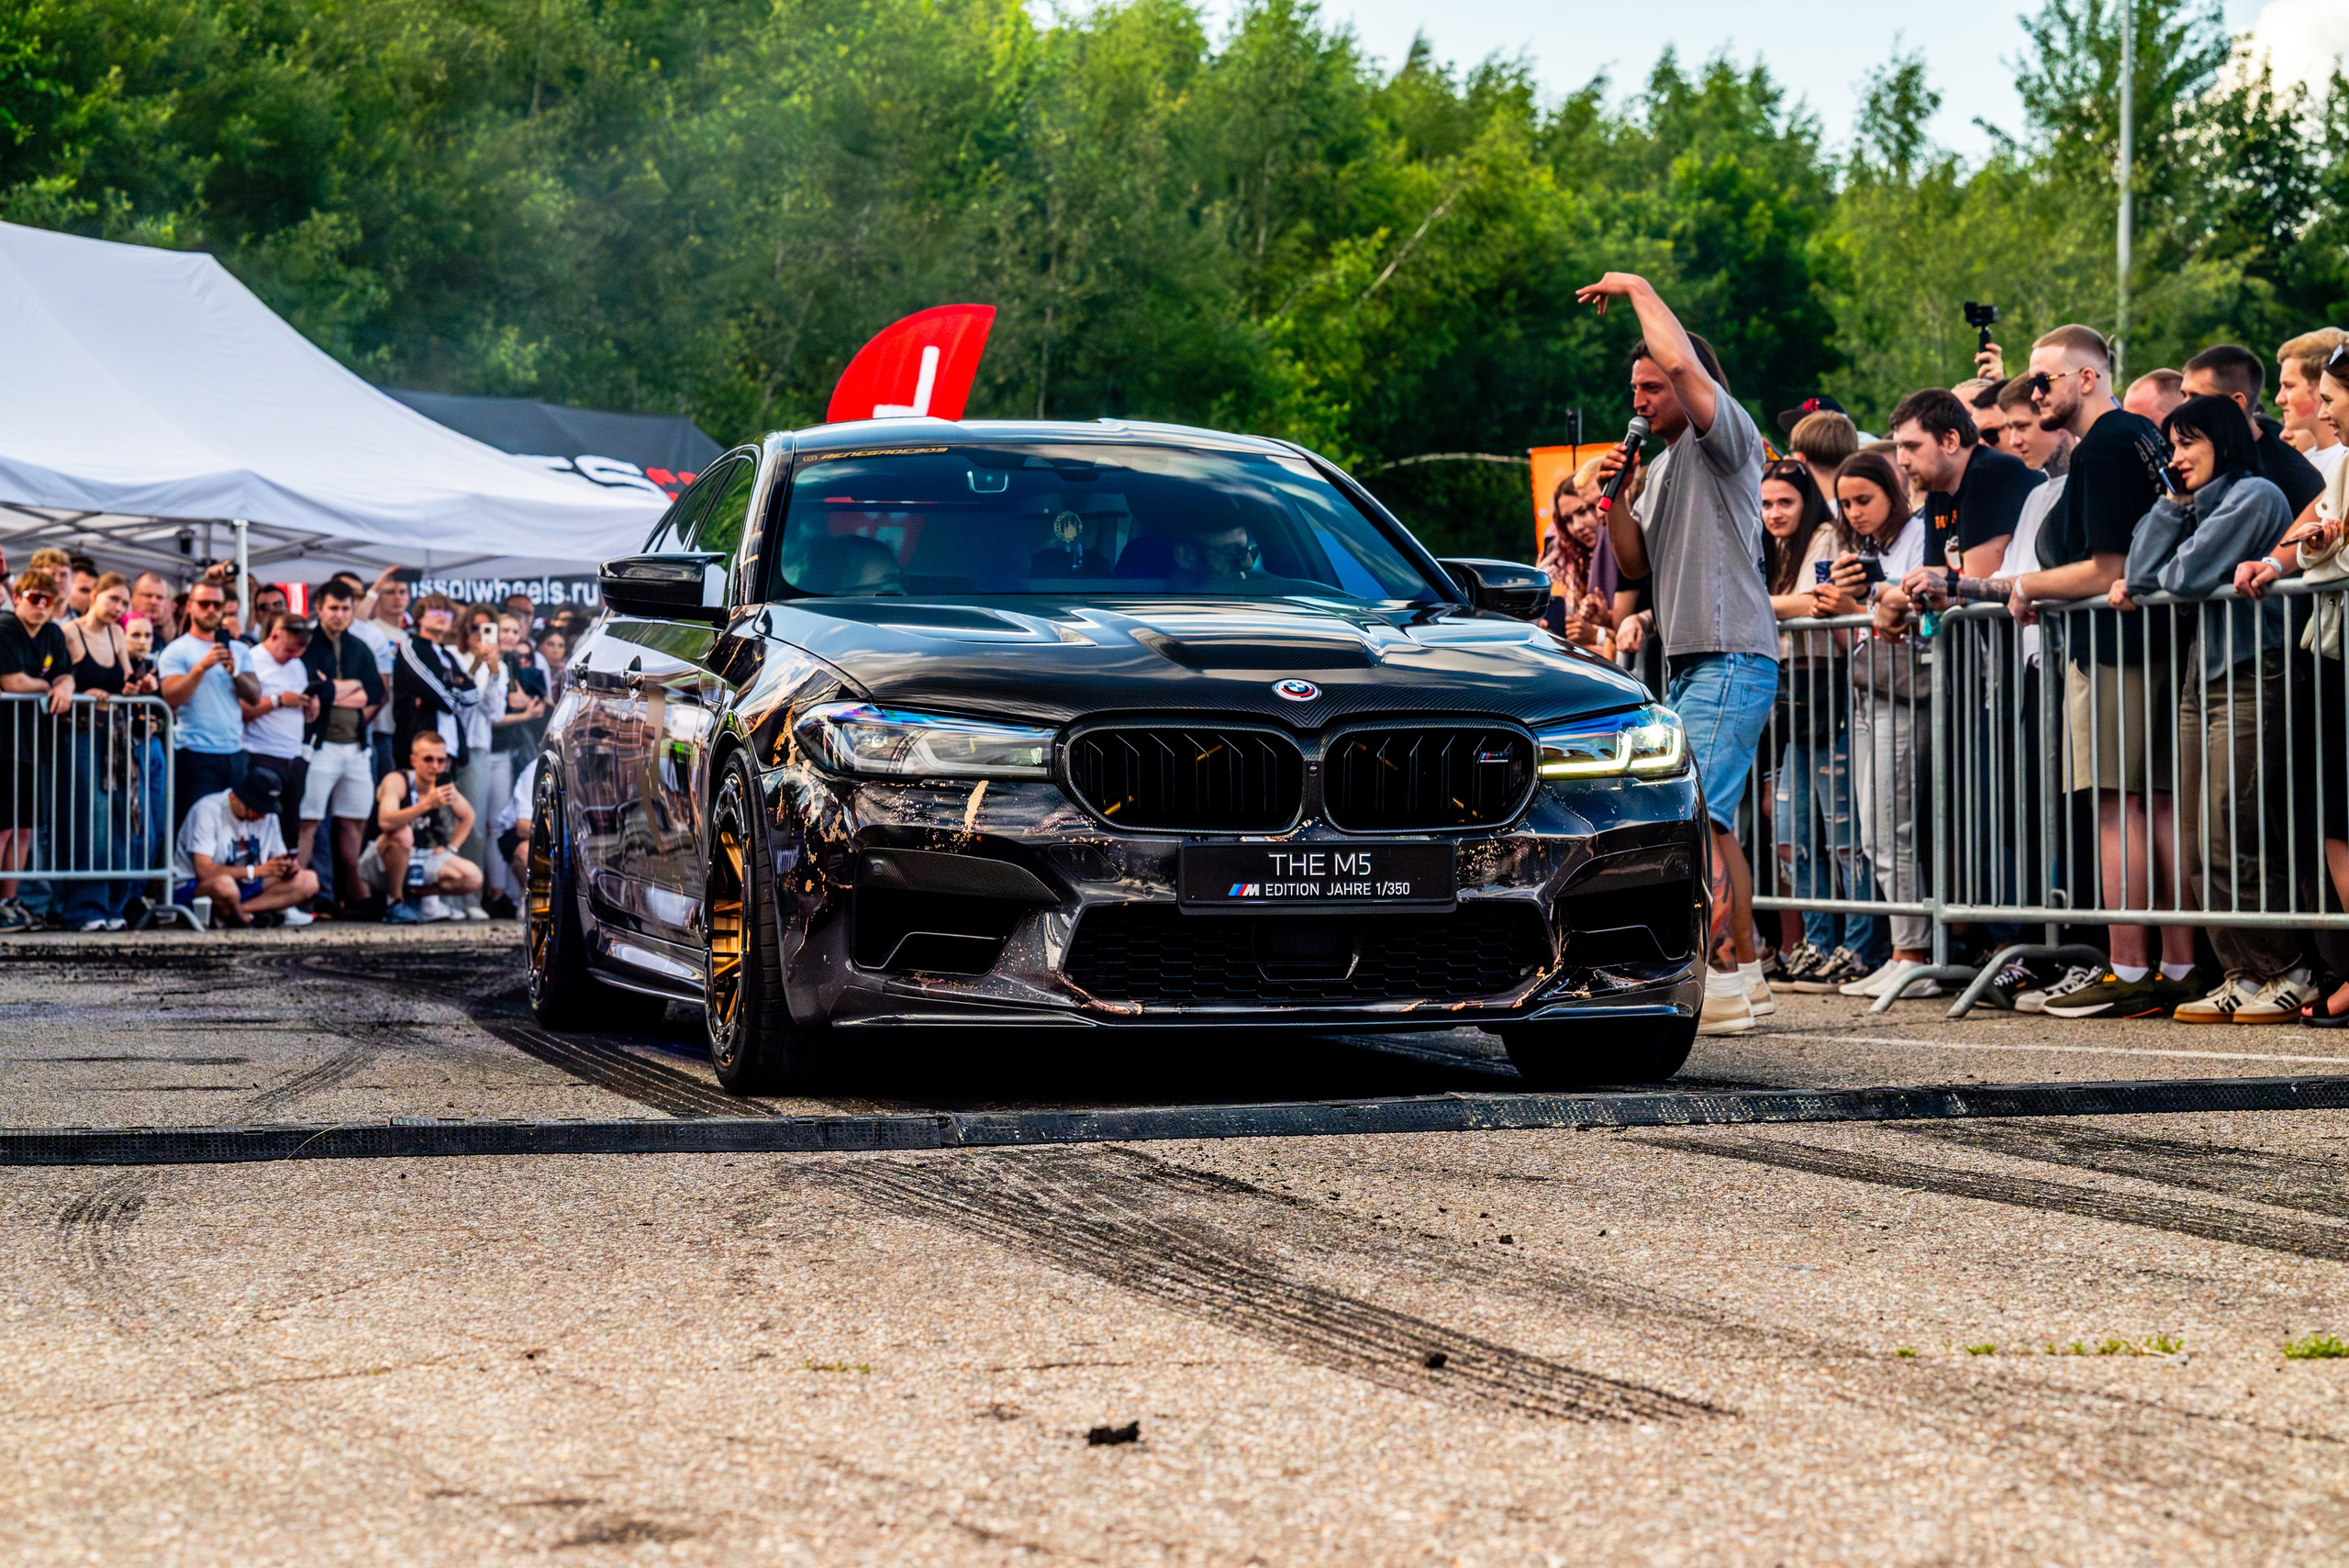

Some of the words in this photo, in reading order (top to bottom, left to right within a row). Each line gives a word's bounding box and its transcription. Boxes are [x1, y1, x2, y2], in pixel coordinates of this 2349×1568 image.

[1268, 852, 1326, 875] THE
[1335, 852, 1371, 875] M5
[1265, 883, 1319, 896] EDITION
[1327, 883, 1372, 896] JAHRE
[1375, 882, 1410, 896] 1/350
